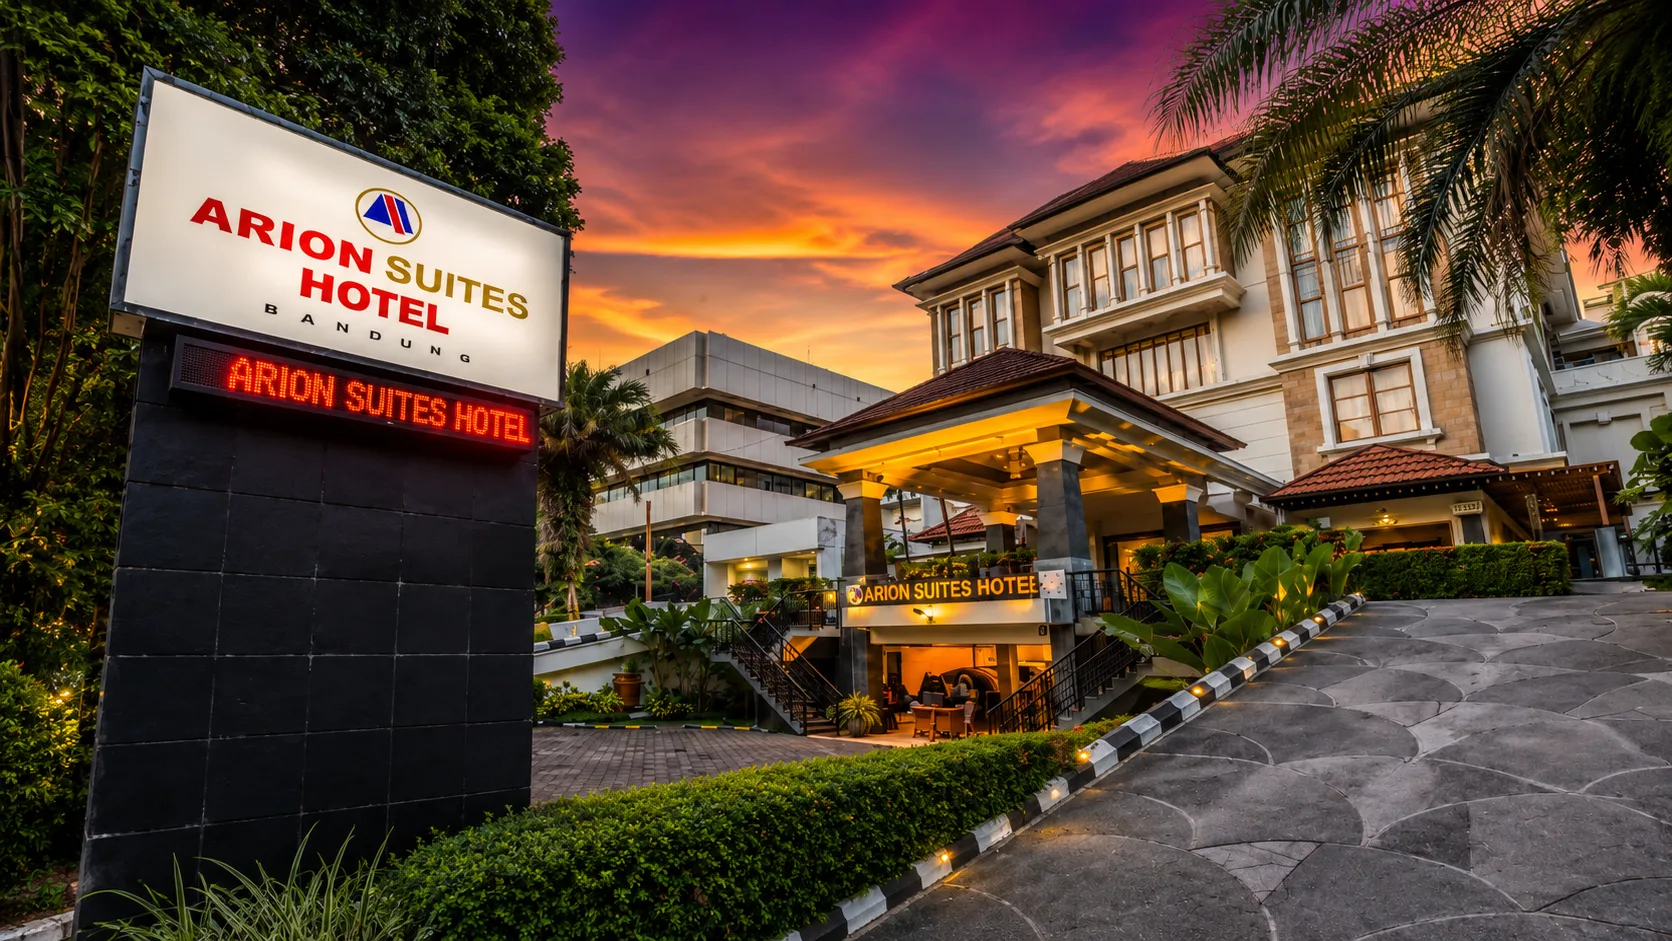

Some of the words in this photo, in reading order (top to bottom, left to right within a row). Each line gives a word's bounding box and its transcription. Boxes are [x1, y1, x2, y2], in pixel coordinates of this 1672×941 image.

[190, 197, 373, 274] ARION
[385, 255, 529, 320] SUITES
[264, 303, 471, 364] BANDUNG
[300, 267, 449, 335] HOTEL
[228, 357, 336, 409] ARION
[346, 379, 447, 429] SUITES
[454, 401, 531, 445] HOTEL
[864, 583, 910, 602] ARION
[914, 579, 972, 599] SUITES
